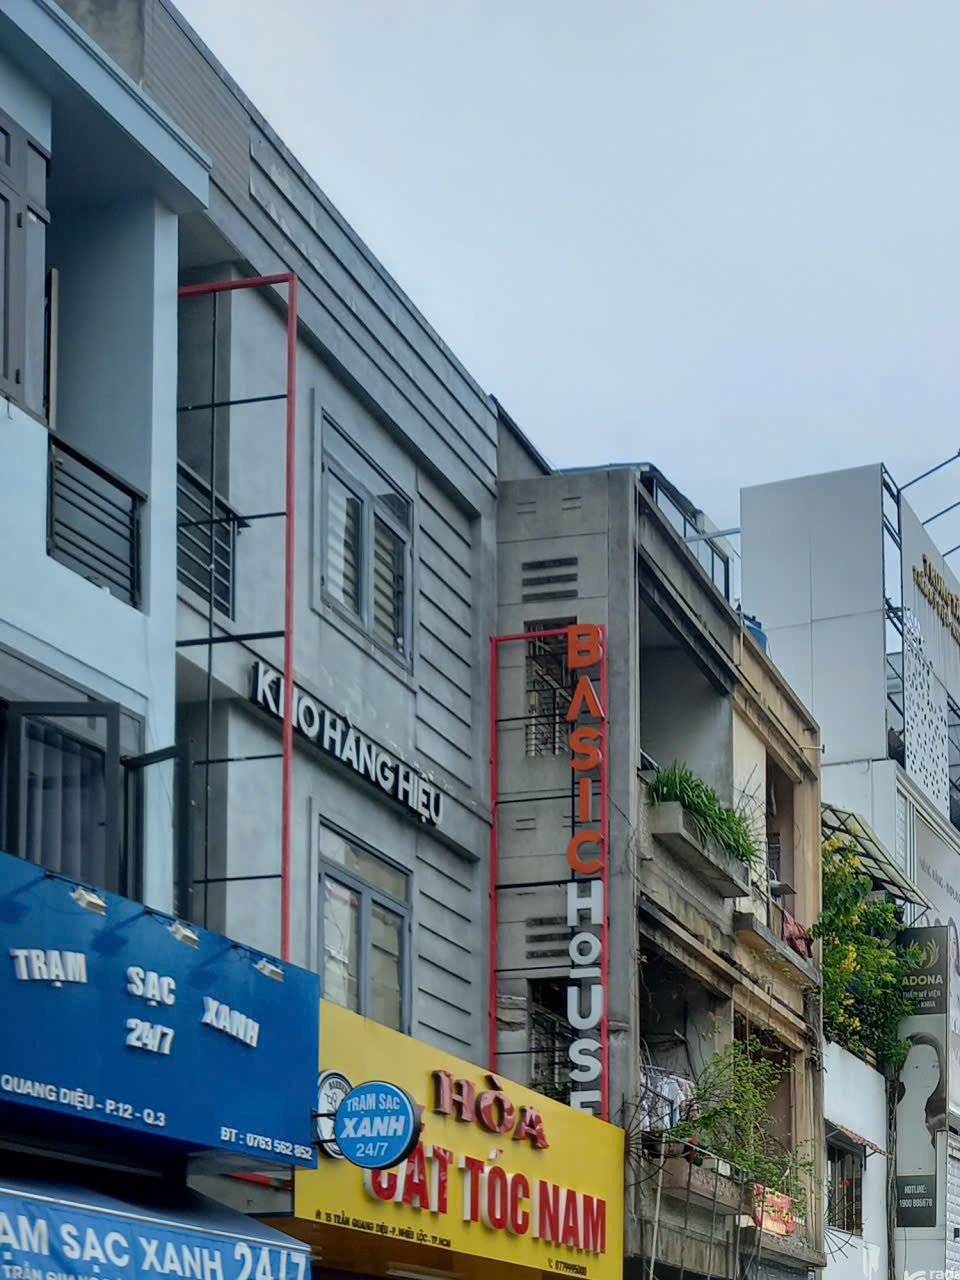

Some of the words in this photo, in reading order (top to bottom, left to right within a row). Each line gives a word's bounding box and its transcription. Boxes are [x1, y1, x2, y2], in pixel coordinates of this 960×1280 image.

[256, 661, 320, 738] KHO
[322, 707, 395, 794] HÀNG
[397, 763, 444, 826] HIỆU
[567, 623, 605, 875] BASIC
[11, 948, 88, 988] TRẠM
[127, 966, 177, 1007] SẠC
[200, 996, 261, 1048] XANH
[901, 974, 943, 986] ADONA
[125, 1018, 175, 1055] 24/7
[1, 1074, 58, 1101] QUANG
[59, 1087, 94, 1111] DIỆU
[105, 1099, 133, 1119] P.12
[143, 1108, 166, 1127] Q.3
[345, 1093, 377, 1114] TRẠM
[378, 1093, 401, 1113] SẠC
[431, 1070, 550, 1150] HÒA
[246, 1133, 273, 1151] 0763
[273, 1138, 293, 1156] 562
[293, 1143, 313, 1161] 852
[340, 1115, 406, 1138] XANH
[355, 1142, 389, 1158] 24/7
[459, 1149, 530, 1235] TÓC
[533, 1179, 606, 1254] NAM
[60, 1223, 130, 1273] SẠC
